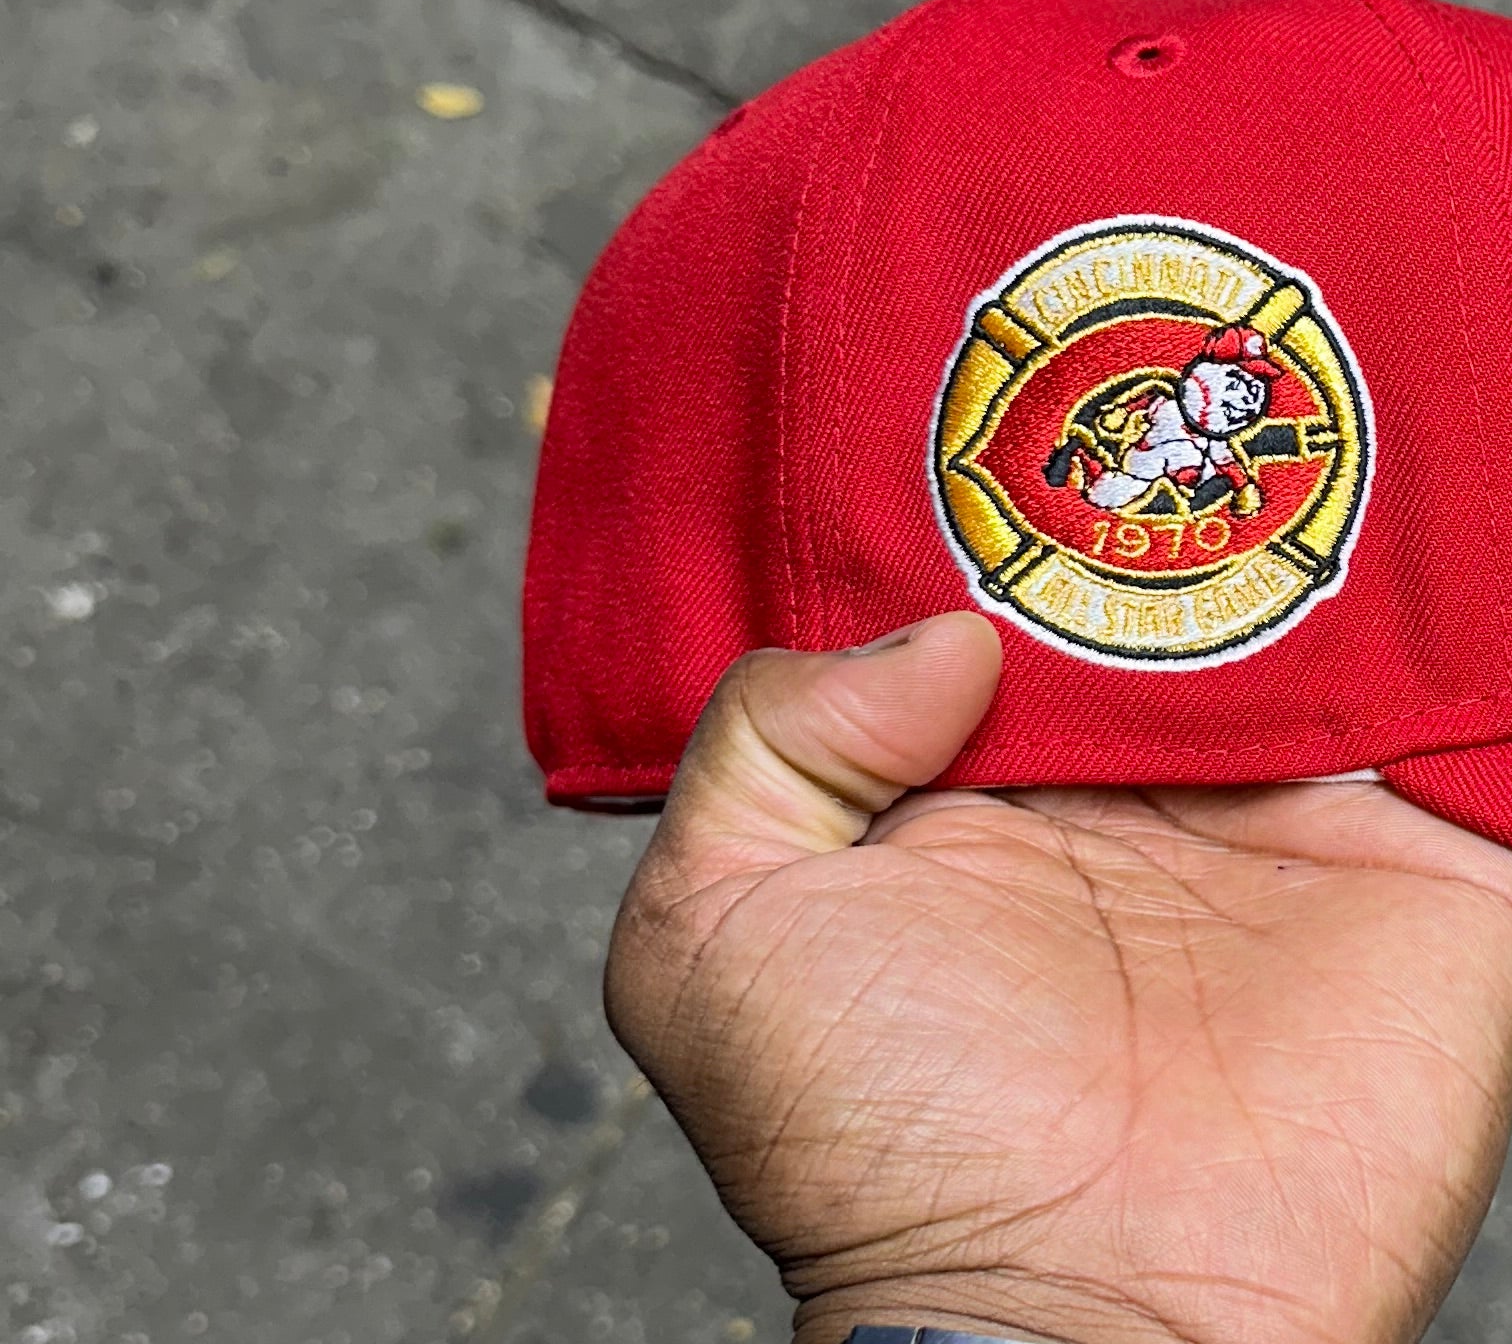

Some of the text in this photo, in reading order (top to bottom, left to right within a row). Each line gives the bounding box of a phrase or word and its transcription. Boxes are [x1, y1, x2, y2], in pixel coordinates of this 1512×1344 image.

[1032, 251, 1243, 324] CINCINNATI
[1092, 516, 1232, 559] 1970
[1036, 559, 1284, 638] ALL STAR GAME
